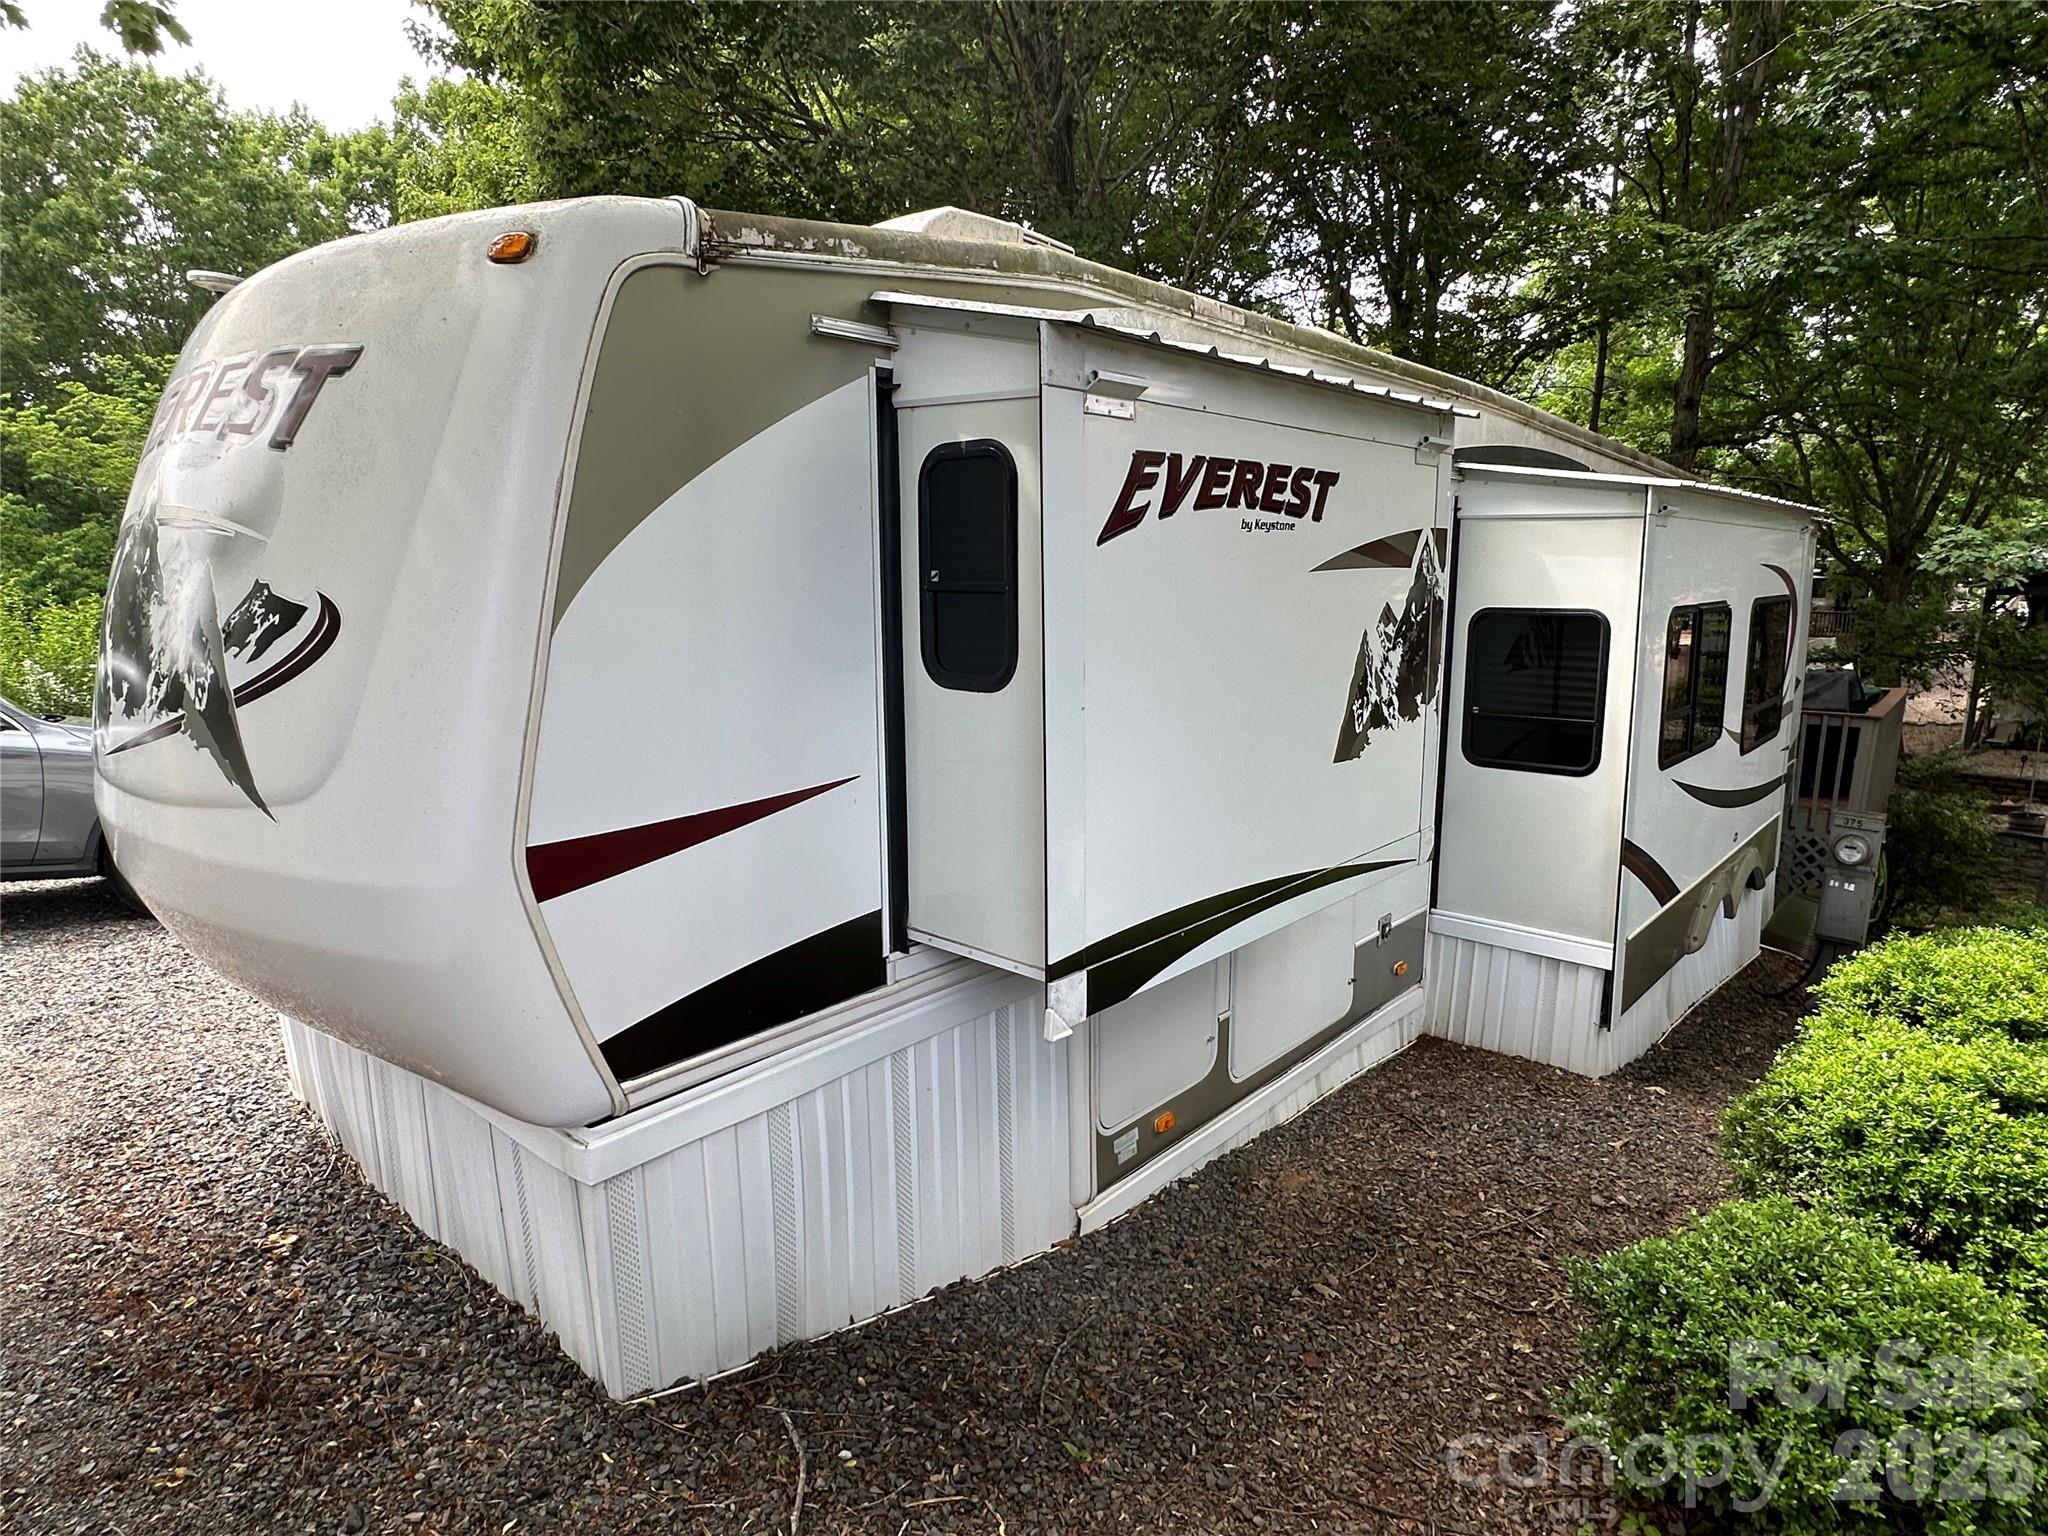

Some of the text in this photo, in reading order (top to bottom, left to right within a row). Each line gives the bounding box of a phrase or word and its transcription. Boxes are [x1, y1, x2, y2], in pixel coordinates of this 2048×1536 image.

[1096, 449, 1340, 547] EVEREST
[1241, 518, 1296, 533] by Keystone
[1843, 817, 1864, 828] 375
